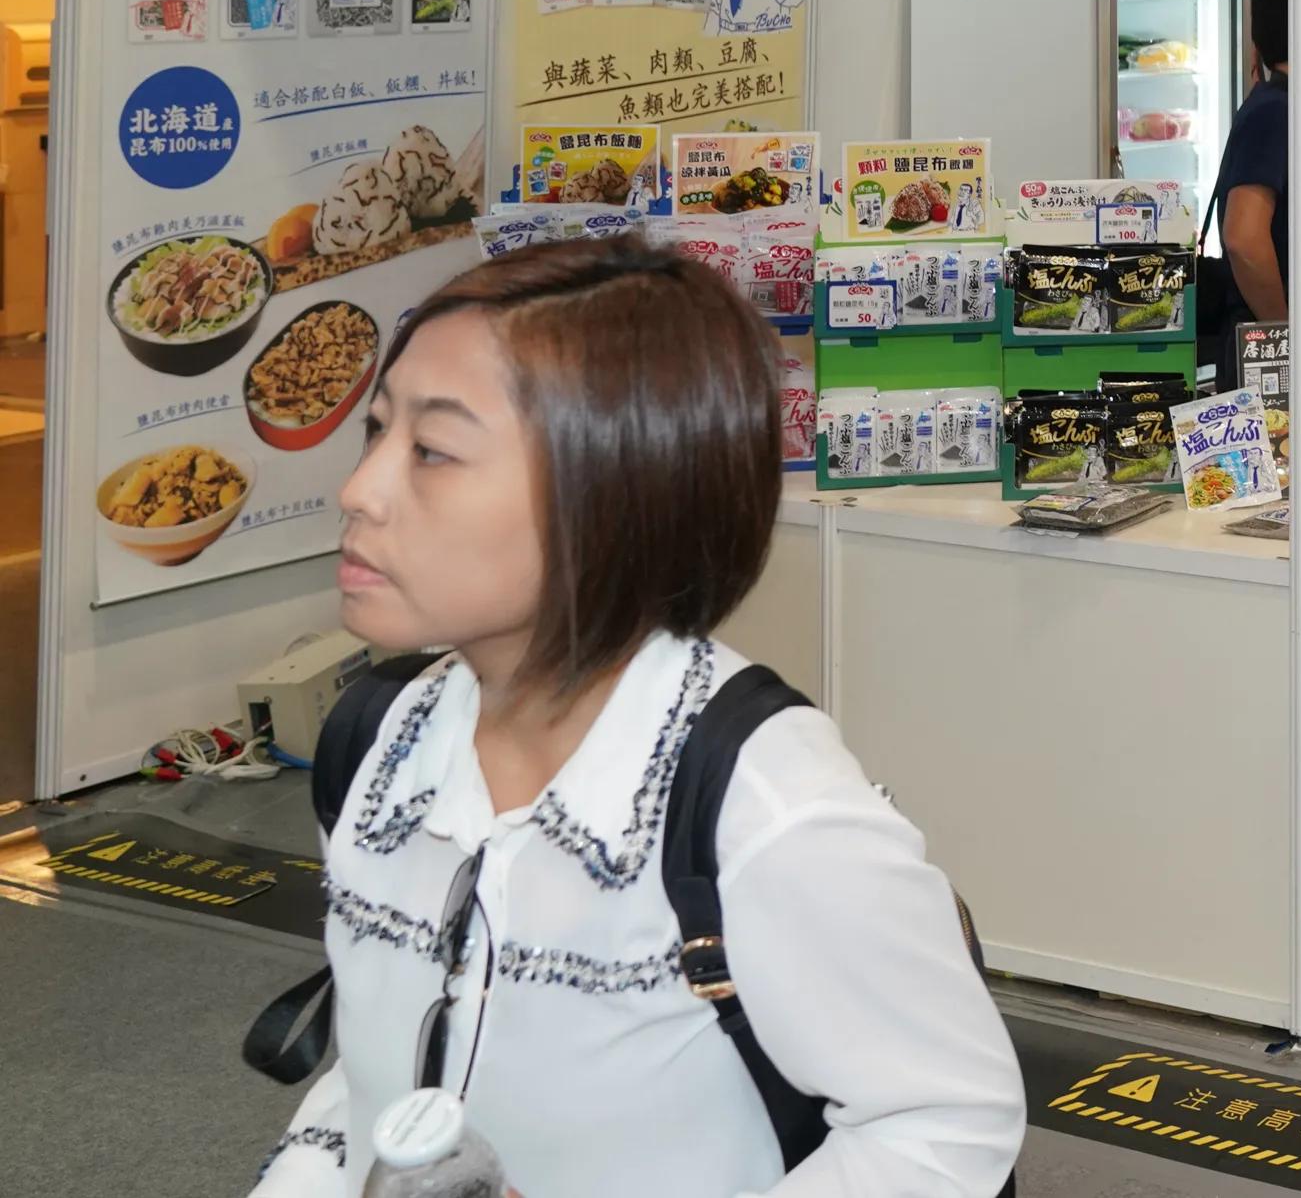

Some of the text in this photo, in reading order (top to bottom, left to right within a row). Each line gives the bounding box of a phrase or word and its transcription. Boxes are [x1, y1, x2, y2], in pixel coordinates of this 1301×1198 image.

[130, 136, 232, 157] 昆布100%使用
[1118, 231, 1136, 240] 100
[1027, 266, 1098, 293] 塩こんぶ
[1118, 266, 1188, 294] 塩こんぶ
[857, 314, 871, 323] 50
[1198, 404, 1239, 424] くらこん
[1030, 418, 1101, 445] 塩こんぶ
[1182, 417, 1263, 456] 塩こんぶ
